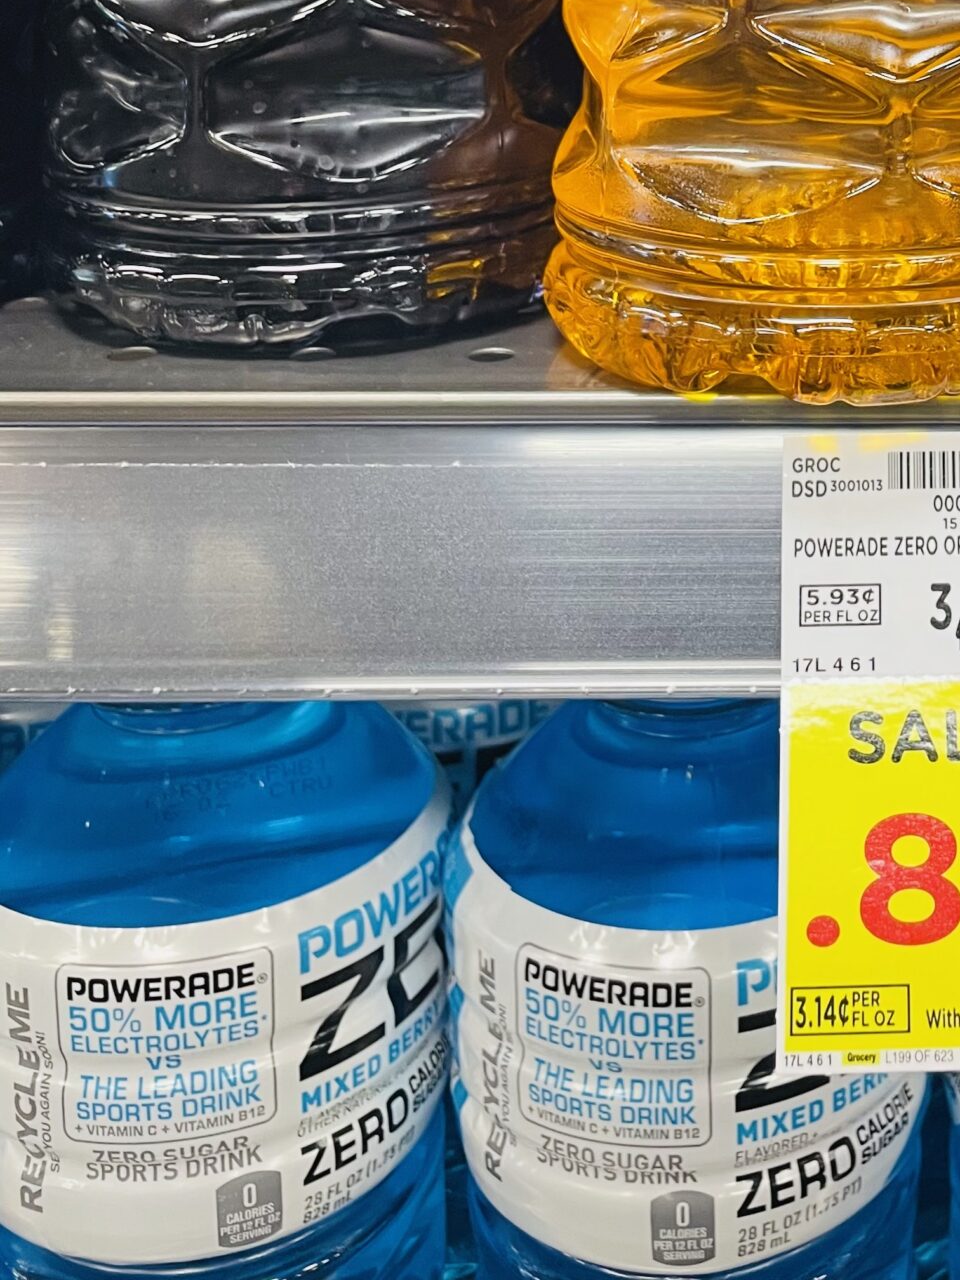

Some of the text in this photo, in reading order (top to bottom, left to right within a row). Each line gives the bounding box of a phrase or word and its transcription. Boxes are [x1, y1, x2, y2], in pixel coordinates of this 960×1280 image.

[792, 457, 841, 473] GROC
[792, 480, 883, 498] DSD 3001013
[943, 518, 957, 529] 15
[794, 538, 888, 558] POWERADE
[895, 537, 938, 555] ZERO
[807, 589, 874, 605] 5.93¢
[804, 610, 878, 622] PER FL OZ
[793, 657, 876, 672] 17L 4 6 1
[67, 962, 255, 1003] POWERADE
[525, 957, 693, 1008] POWERADE
[69, 991, 258, 1033] 50% MORE
[525, 987, 694, 1038] 50% MORE
[795, 991, 880, 1028] 3.14¢ PER
[852, 1010, 895, 1027] FL OZ
[926, 1009, 960, 1029] With
[71, 1020, 259, 1054] ELECTROLYTES
[525, 1016, 696, 1061] ELECTROLYTES
[784, 1055, 803, 1067] 17L
[807, 1055, 813, 1066] 4
[817, 1055, 823, 1065] 6
[847, 1052, 876, 1064] Grocery
[885, 1052, 911, 1064] L199
[915, 1051, 930, 1063] OF
[934, 1051, 953, 1062] 623
[80, 1059, 257, 1100] THE LEADING
[301, 1054, 381, 1114] MIXED
[6, 982, 47, 1213] RECYCLE ME
[77, 1084, 262, 1122] SPORTS DRINK
[301, 1088, 409, 1186] ZERO
[737, 1100, 824, 1145] MIXED
[736, 1135, 856, 1218] ZERO
[676, 1202, 690, 1227] 0
